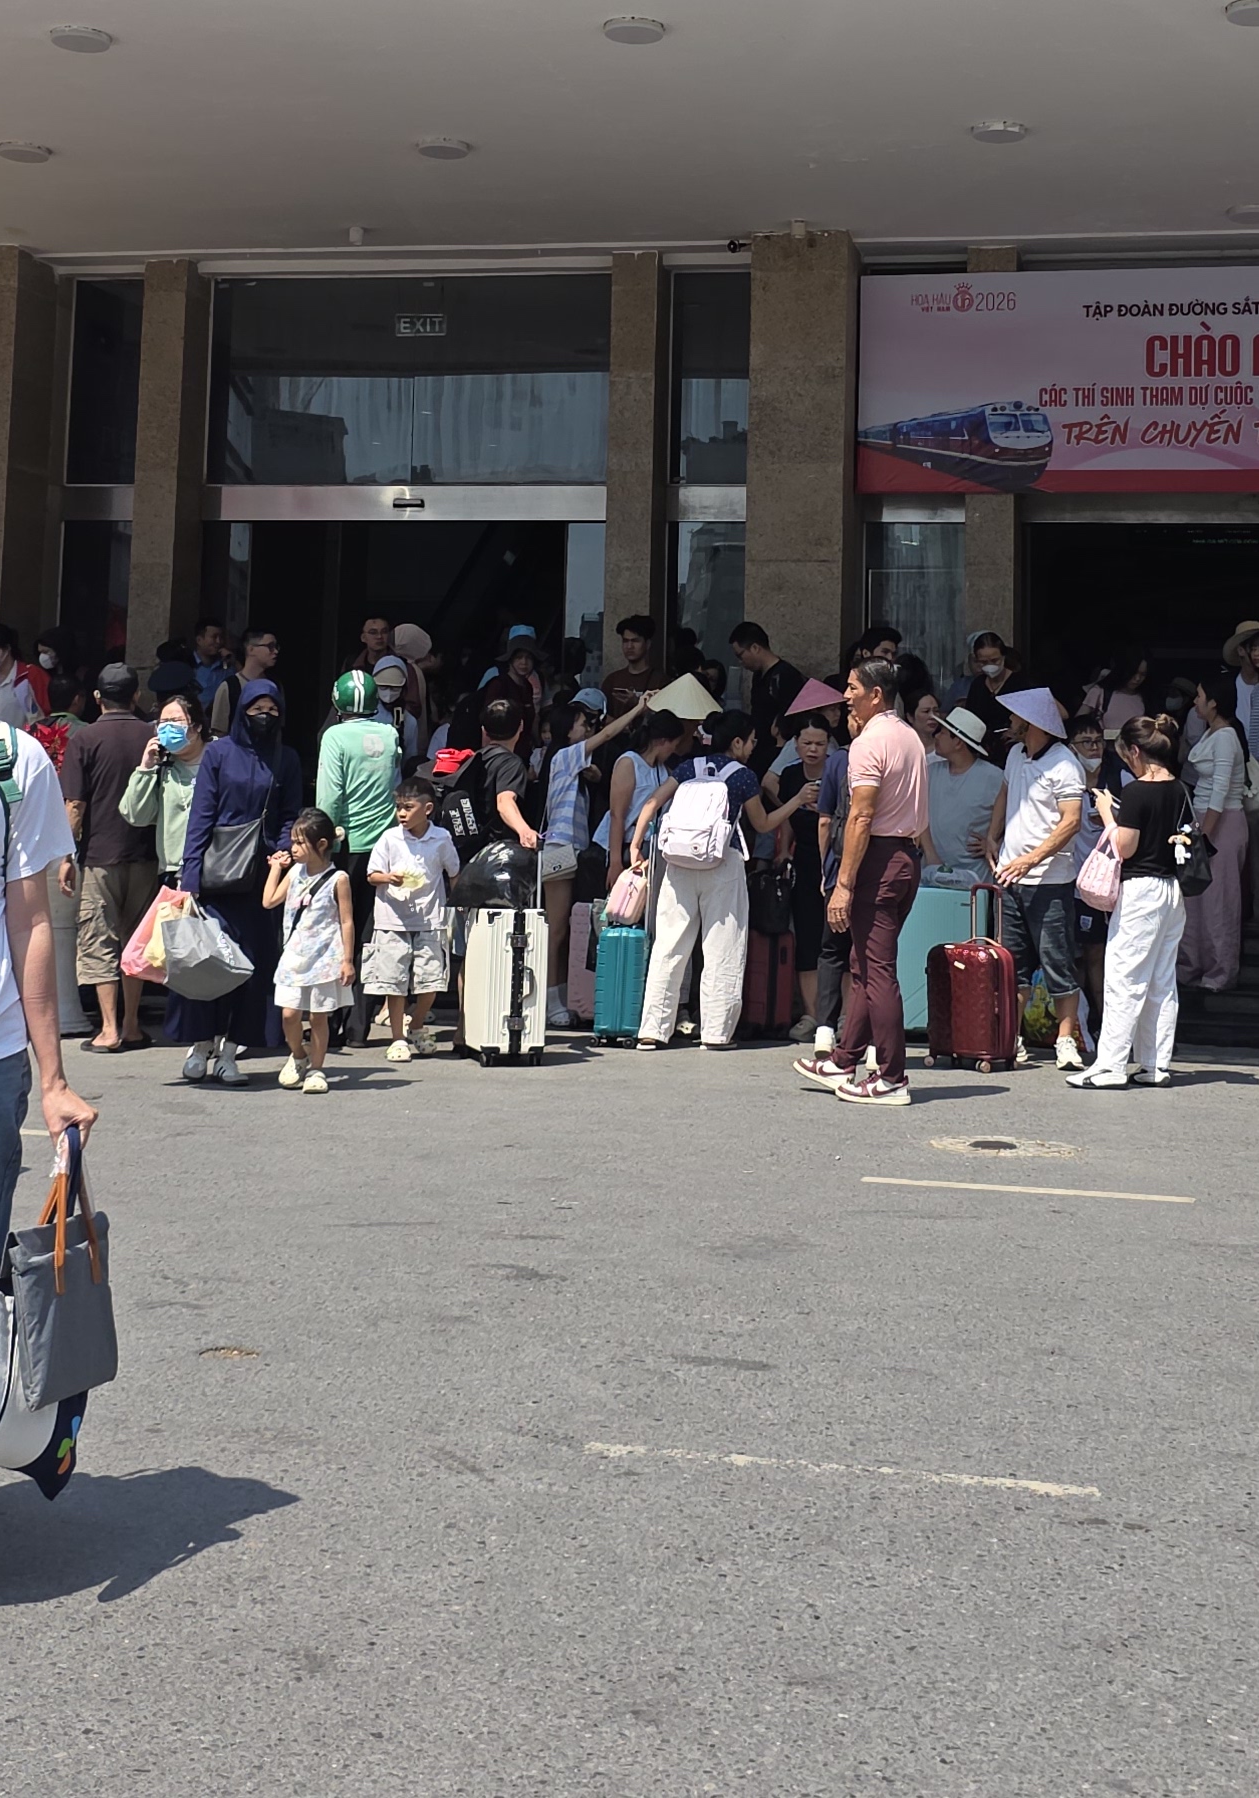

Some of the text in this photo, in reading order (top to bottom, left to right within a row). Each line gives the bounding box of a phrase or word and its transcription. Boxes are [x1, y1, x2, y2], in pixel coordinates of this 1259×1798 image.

[975, 291, 1016, 312] 2026
[1082, 295, 1259, 321] TẬP ĐOÀN ĐƯỜNG SẮT
[400, 318, 443, 332] EXIT
[1145, 320, 1241, 378] CHÀO
[1038, 380, 1254, 410] CÁC THÍ SINH THAM DỰ CUỘC
[1062, 408, 1244, 448] TRÊN CHUYẾN
